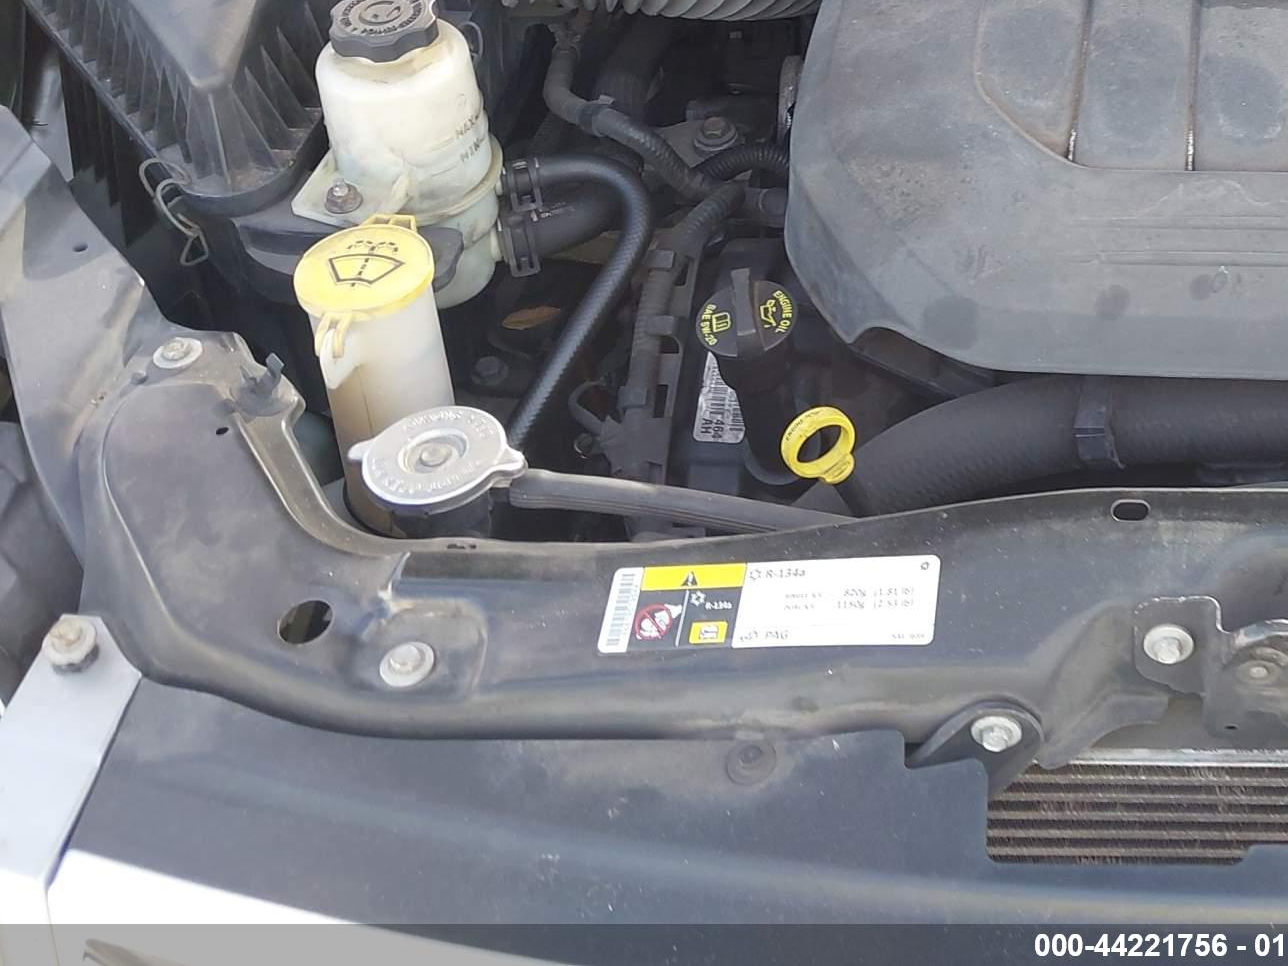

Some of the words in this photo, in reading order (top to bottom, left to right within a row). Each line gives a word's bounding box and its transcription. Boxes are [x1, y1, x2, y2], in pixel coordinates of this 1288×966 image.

[701, 304, 717, 320] SAE
[772, 290, 793, 318] ENGINE
[700, 321, 718, 346] 5W-20
[775, 320, 791, 333] OIL
[764, 567, 806, 579] R-134a
